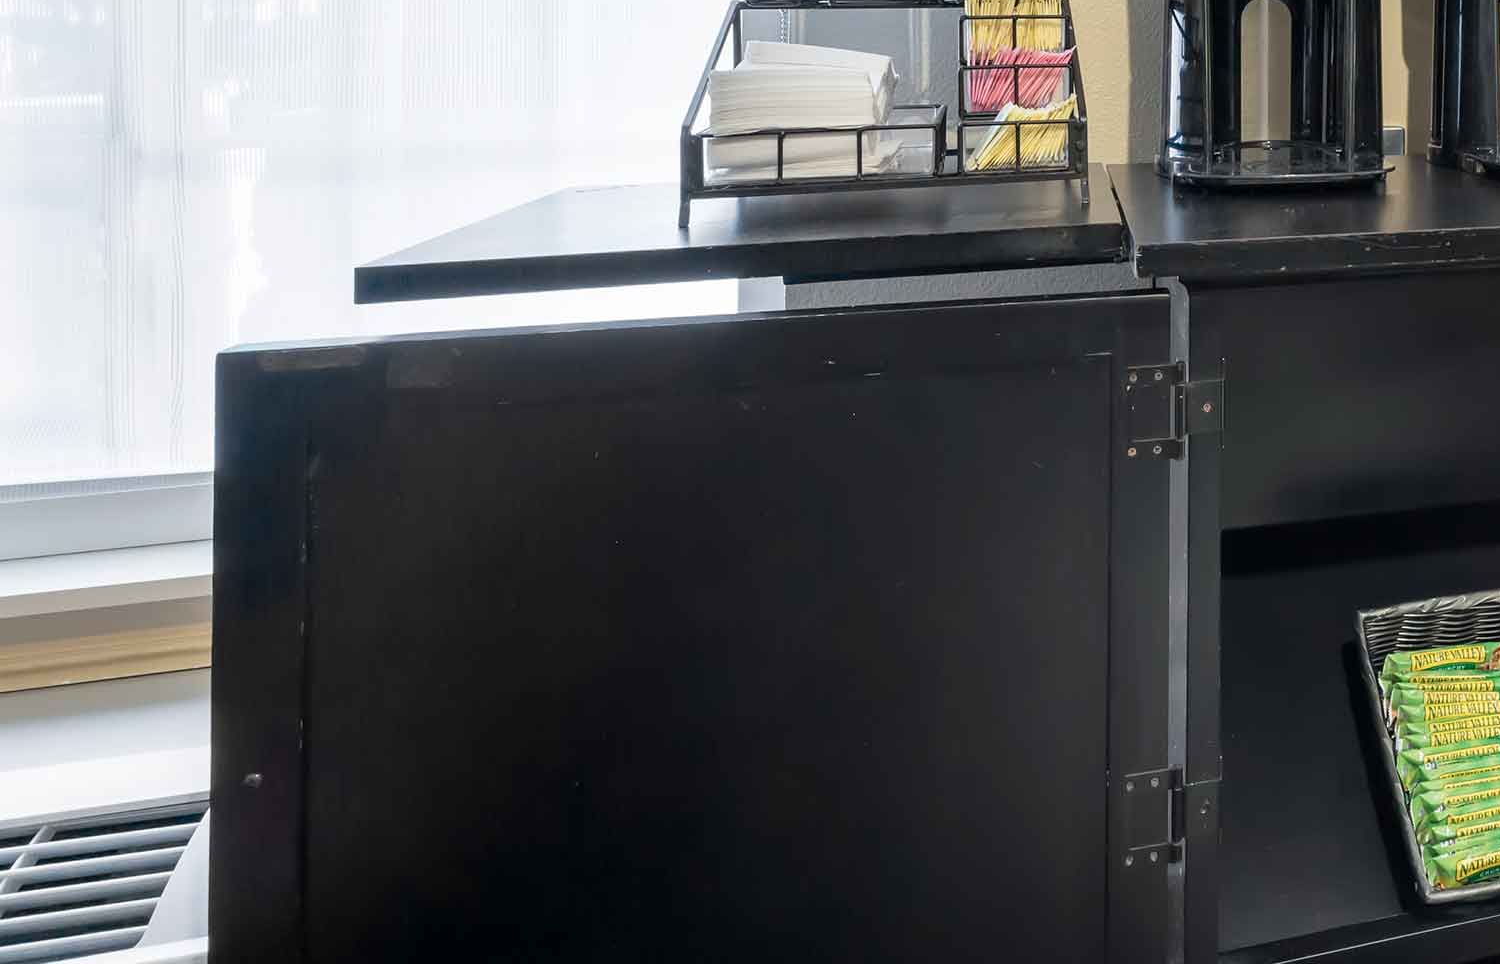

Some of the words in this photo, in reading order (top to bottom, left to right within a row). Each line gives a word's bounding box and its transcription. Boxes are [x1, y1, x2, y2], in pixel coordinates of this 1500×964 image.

[1414, 652, 1451, 668] NATURE
[1451, 647, 1482, 661] VALLEY
[1428, 703, 1464, 720] NATURE
[1464, 700, 1498, 714] VALLEY
[1433, 731, 1471, 746] NATURE
[1459, 856, 1500, 877] NATURE
